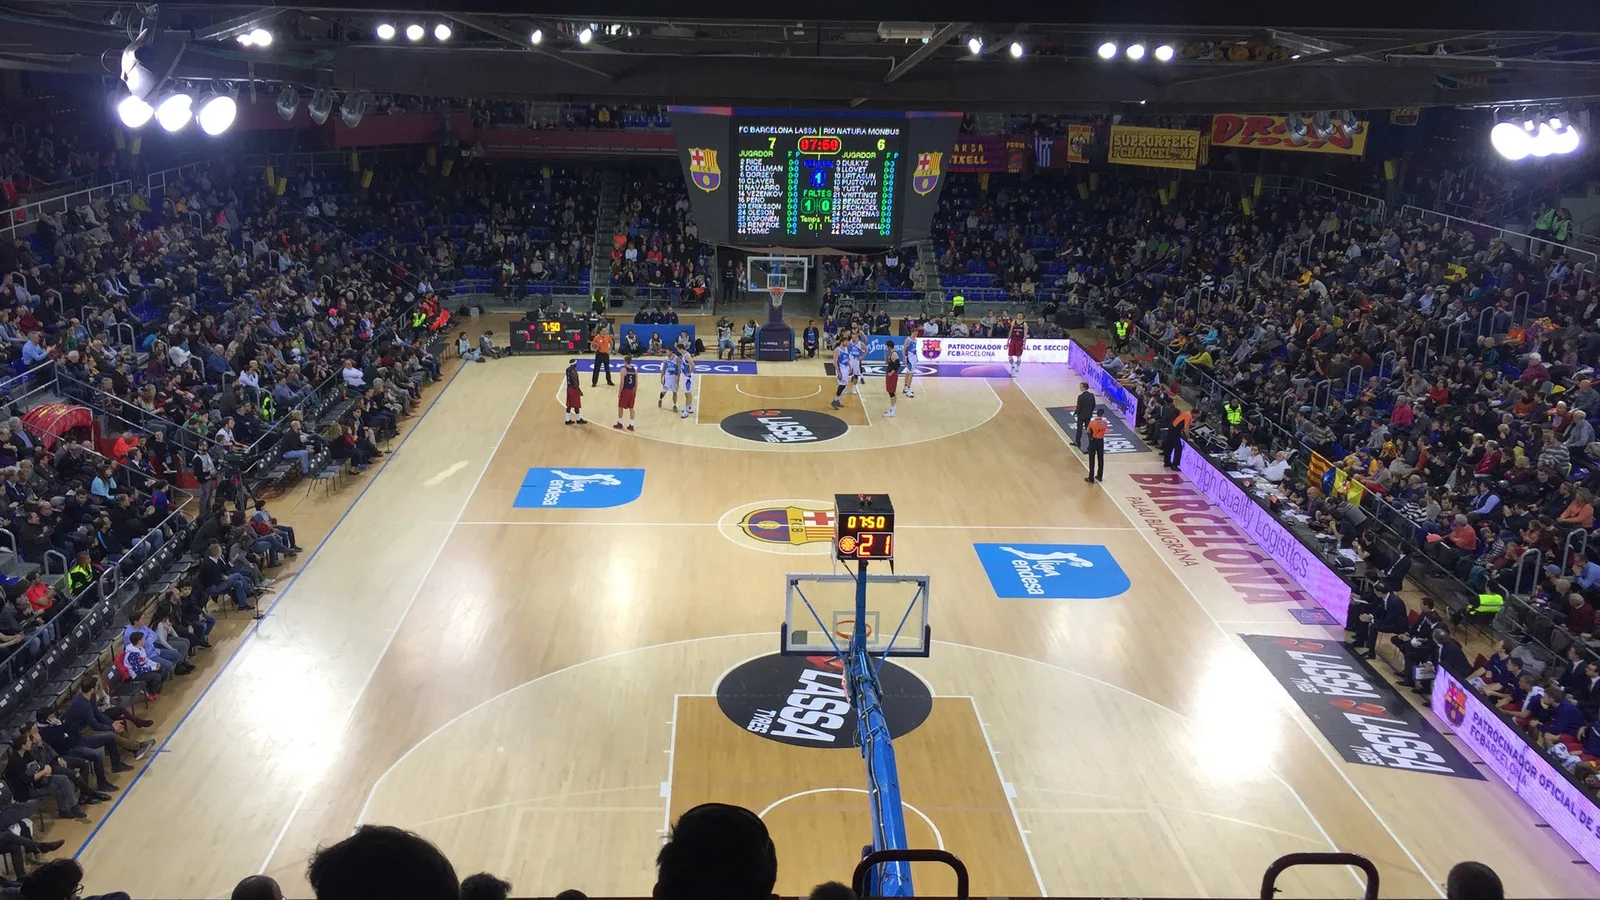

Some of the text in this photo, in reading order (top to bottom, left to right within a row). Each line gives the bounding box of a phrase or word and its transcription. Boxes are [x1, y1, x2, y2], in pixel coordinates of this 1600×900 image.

[750, 126, 793, 134] BARCELONA
[768, 137, 777, 149] 7
[1113, 133, 1197, 148] SUPPORTERS
[877, 139, 886, 150] 6
[950, 155, 988, 164] TXELL
[815, 172, 821, 184] 1
[804, 200, 811, 211] 1
[822, 200, 830, 211] 0
[542, 322, 560, 332] 7:50
[628, 375, 635, 385] 5
[757, 416, 818, 442] LASSA
[542, 480, 566, 506] endesa
[847, 516, 886, 529] 07:50
[1194, 455, 1310, 578] High Quality Logistics
[1126, 496, 1200, 568] PALAU BLAUGRANA
[1128, 473, 1307, 605] BARCELONA
[1011, 559, 1045, 595] endesa
[1285, 650, 1382, 699] LASSA
[770, 668, 851, 742] LASSA
[747, 708, 777, 734] TYRES
[1342, 712, 1456, 774] LASSA
[1470, 727, 1527, 786] FCBARCELONA
[1472, 711, 1538, 778] PATROCINADOR
[1539, 774, 1577, 818] OFICIAL
[1579, 811, 1593, 833] DE
